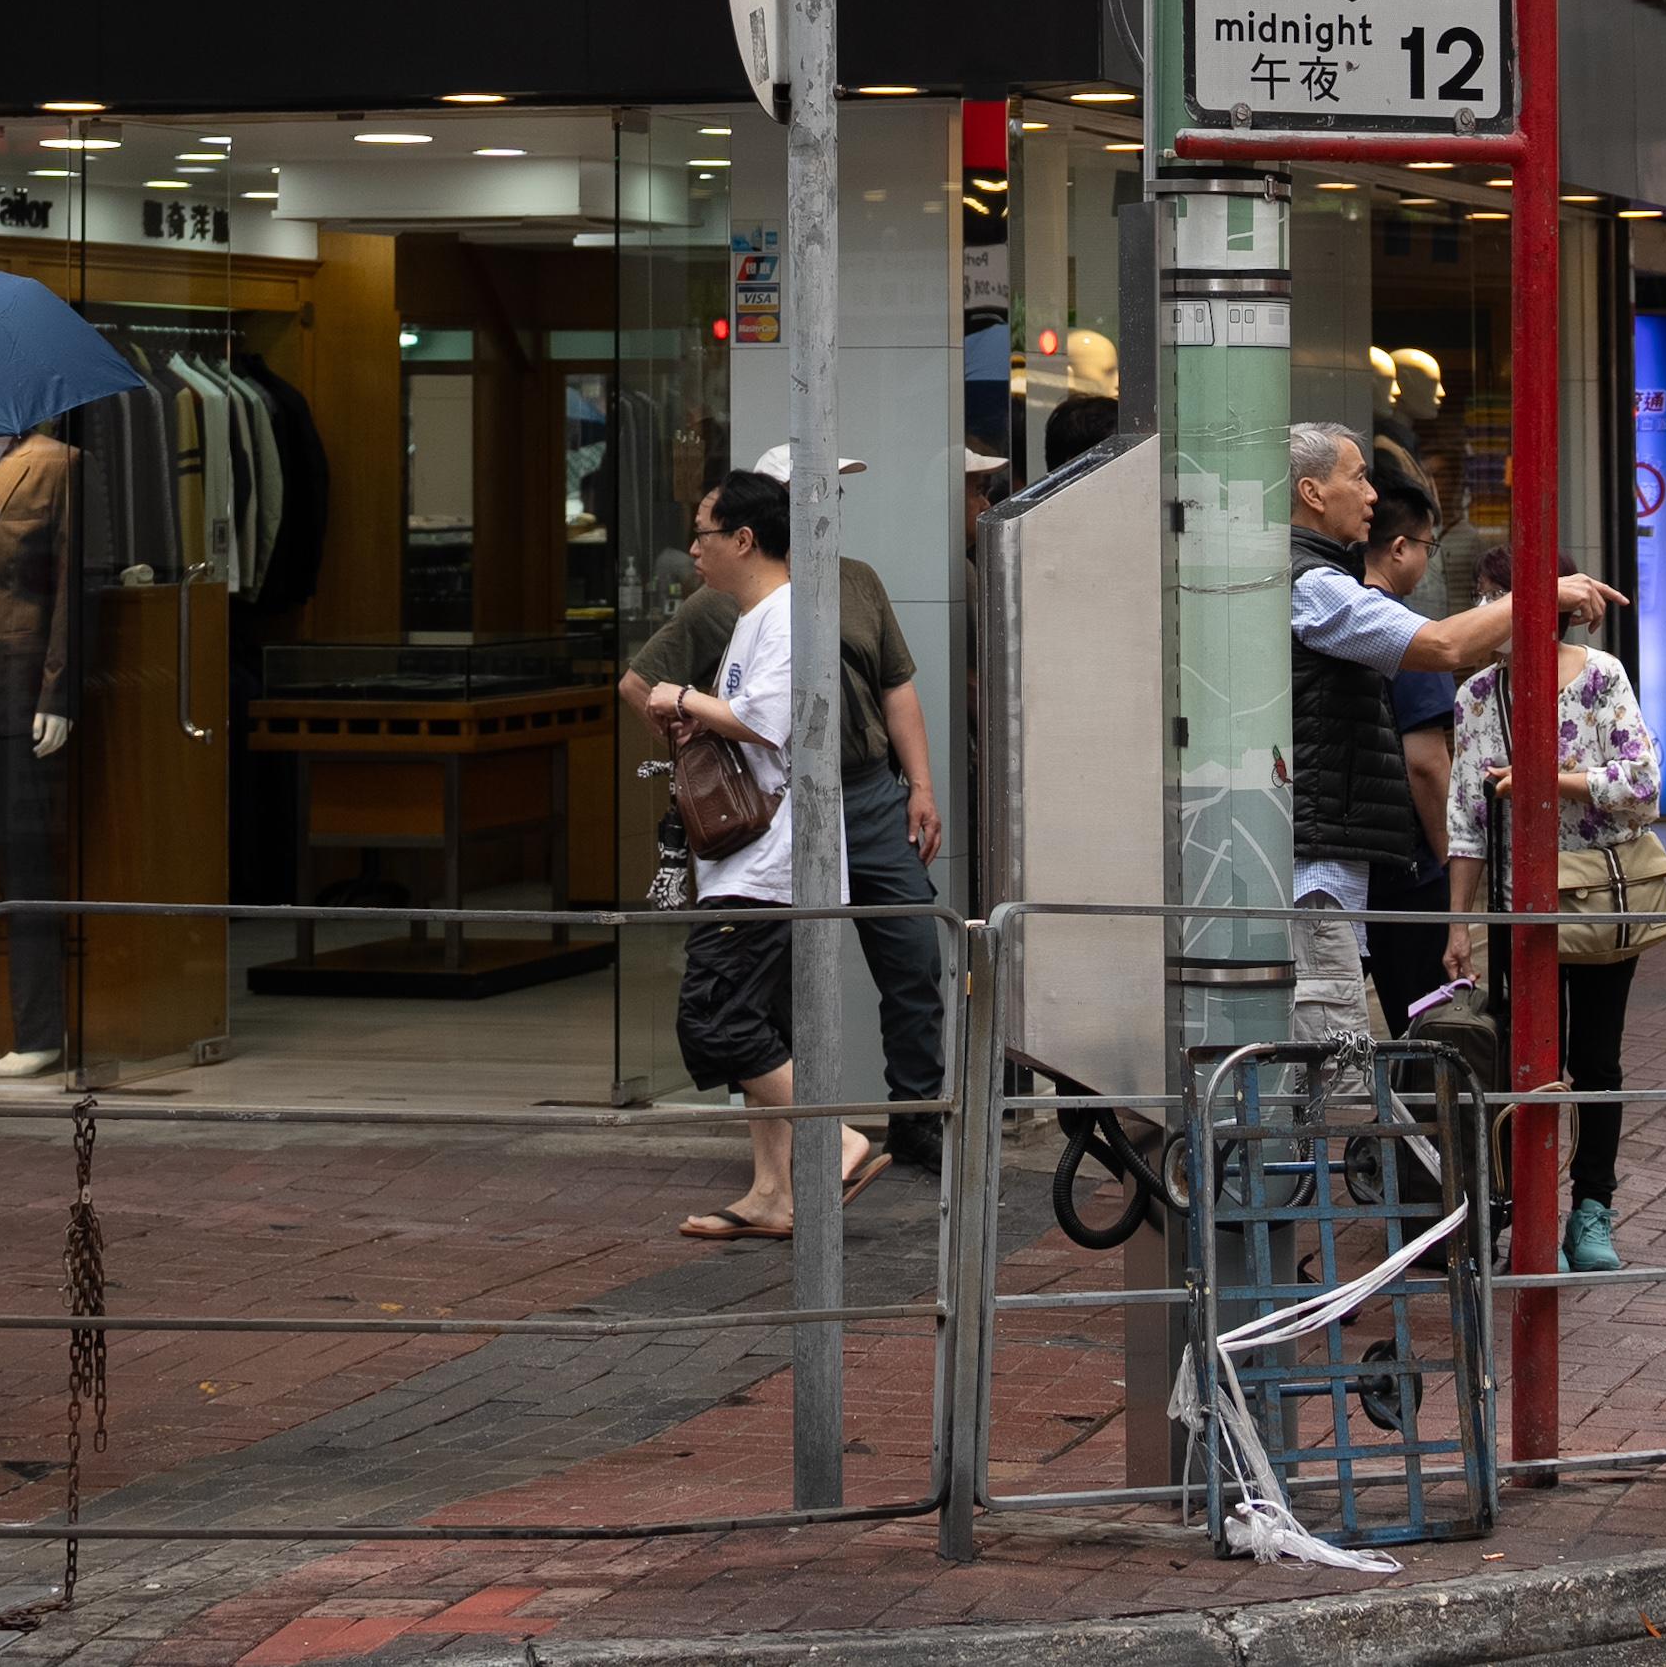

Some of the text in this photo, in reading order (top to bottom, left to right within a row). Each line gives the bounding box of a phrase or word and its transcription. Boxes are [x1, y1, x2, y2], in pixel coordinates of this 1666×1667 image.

[1214, 10, 1373, 52] midnight
[1250, 53, 1341, 103] 午夜
[1401, 26, 1485, 102] 12
[744, 293, 772, 304] VISA
